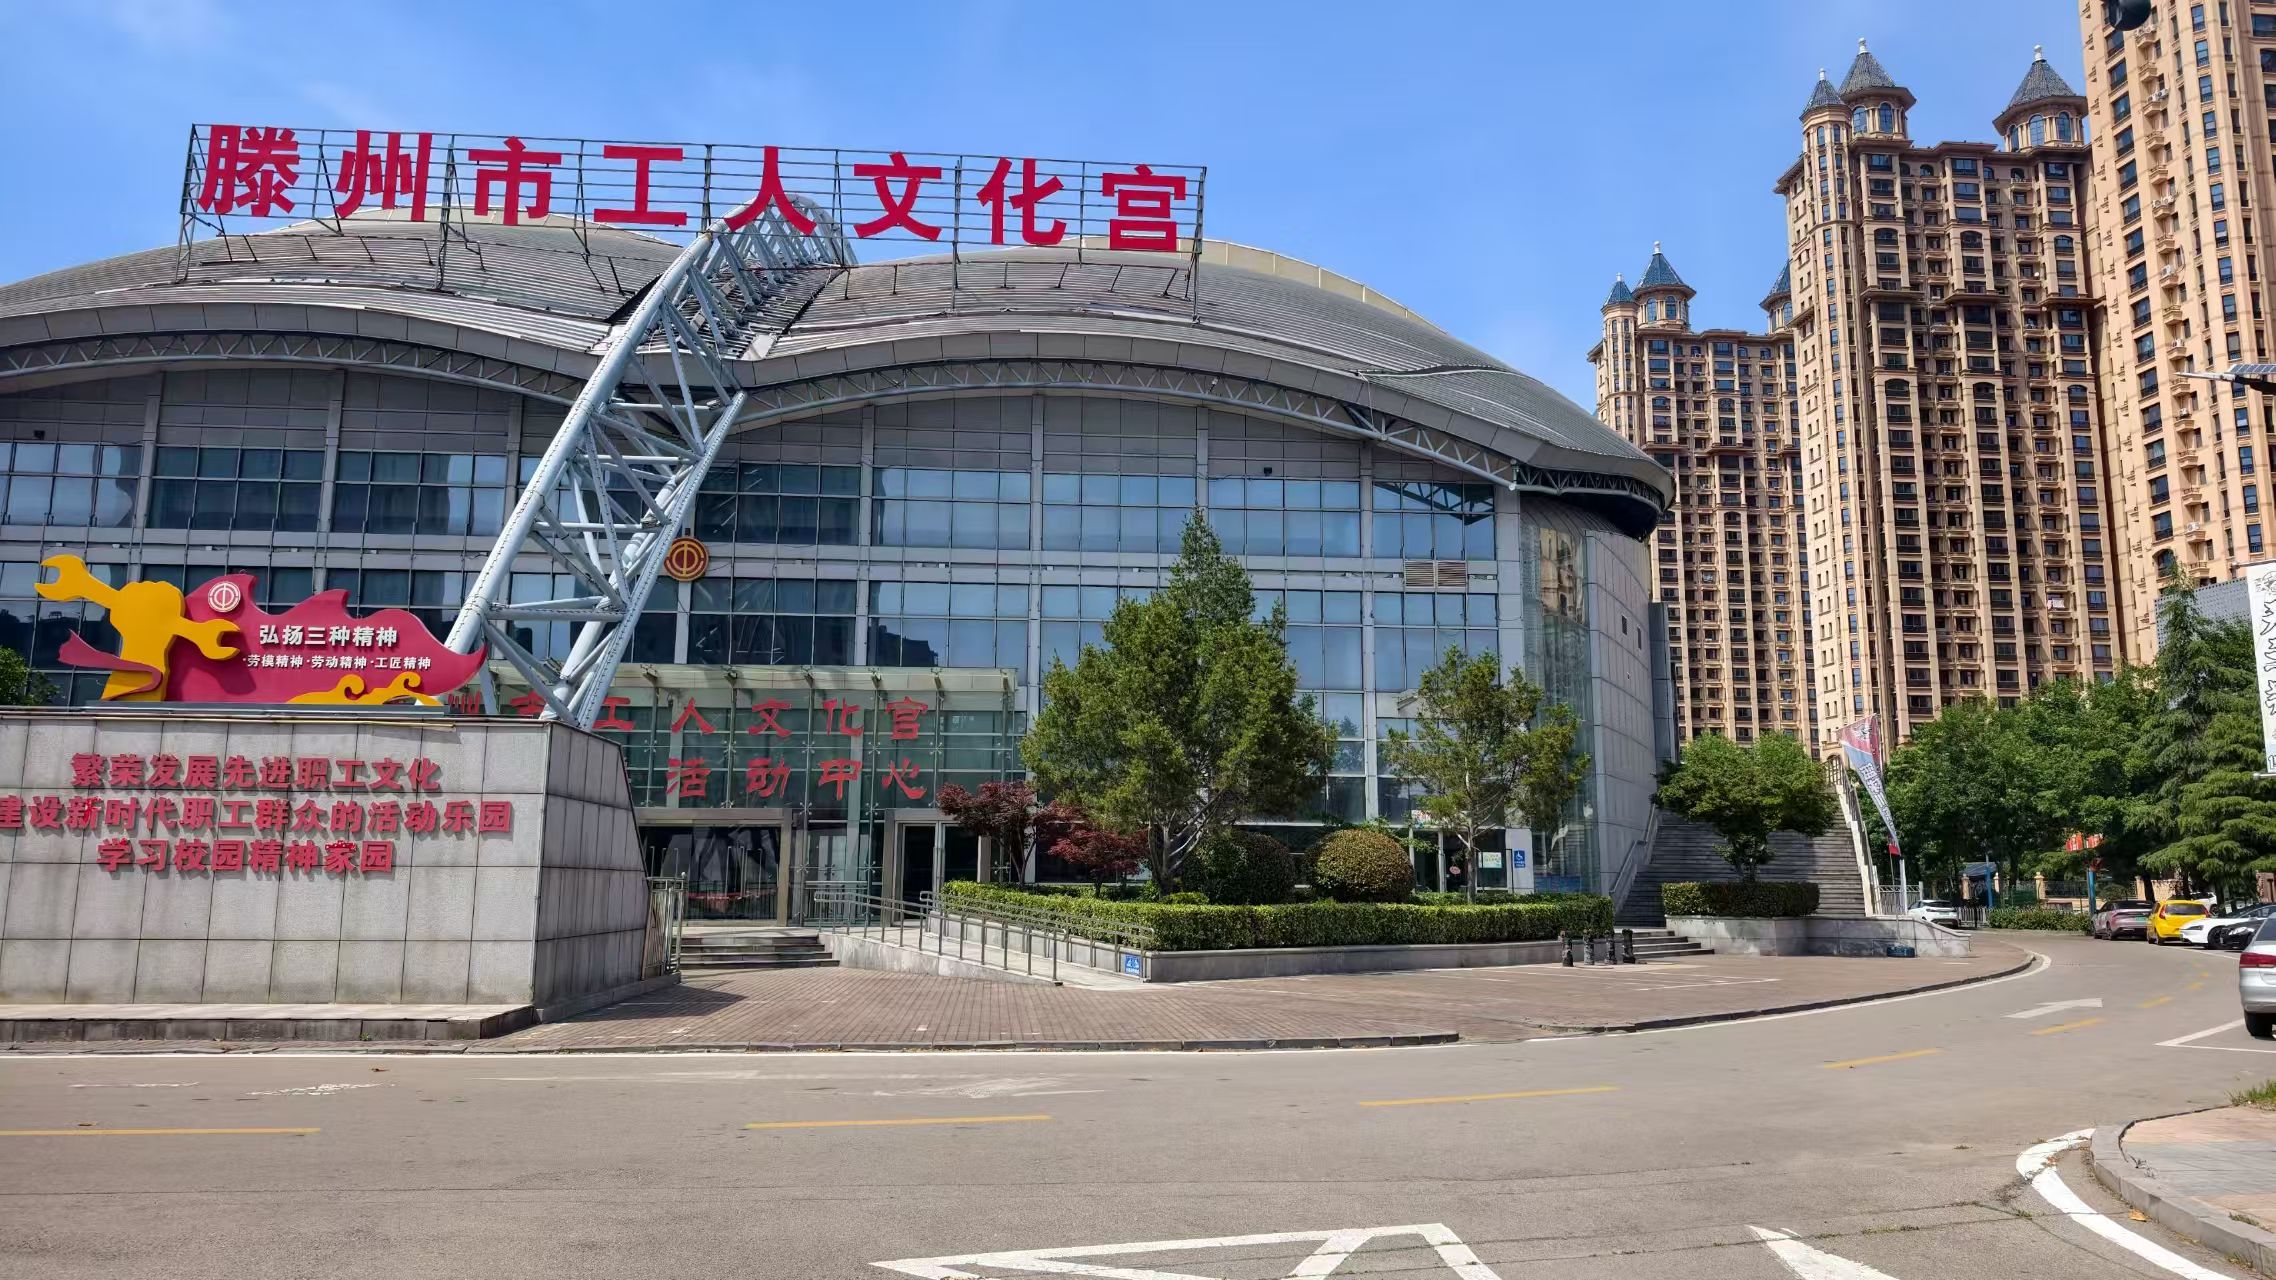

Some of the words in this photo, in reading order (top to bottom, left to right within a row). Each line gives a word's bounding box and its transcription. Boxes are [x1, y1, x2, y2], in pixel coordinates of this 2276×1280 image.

[196, 122, 1186, 252] 滕州市工人文化宫
[259, 624, 398, 648] 弘扬三种精神
[71, 753, 440, 791] 繁荣发展先进职工文化
[666, 756, 927, 801] 活动中心
[0, 795, 512, 833] 建设新时代职工群众的活动乐园
[96, 838, 394, 874] 学习校园精神家园
